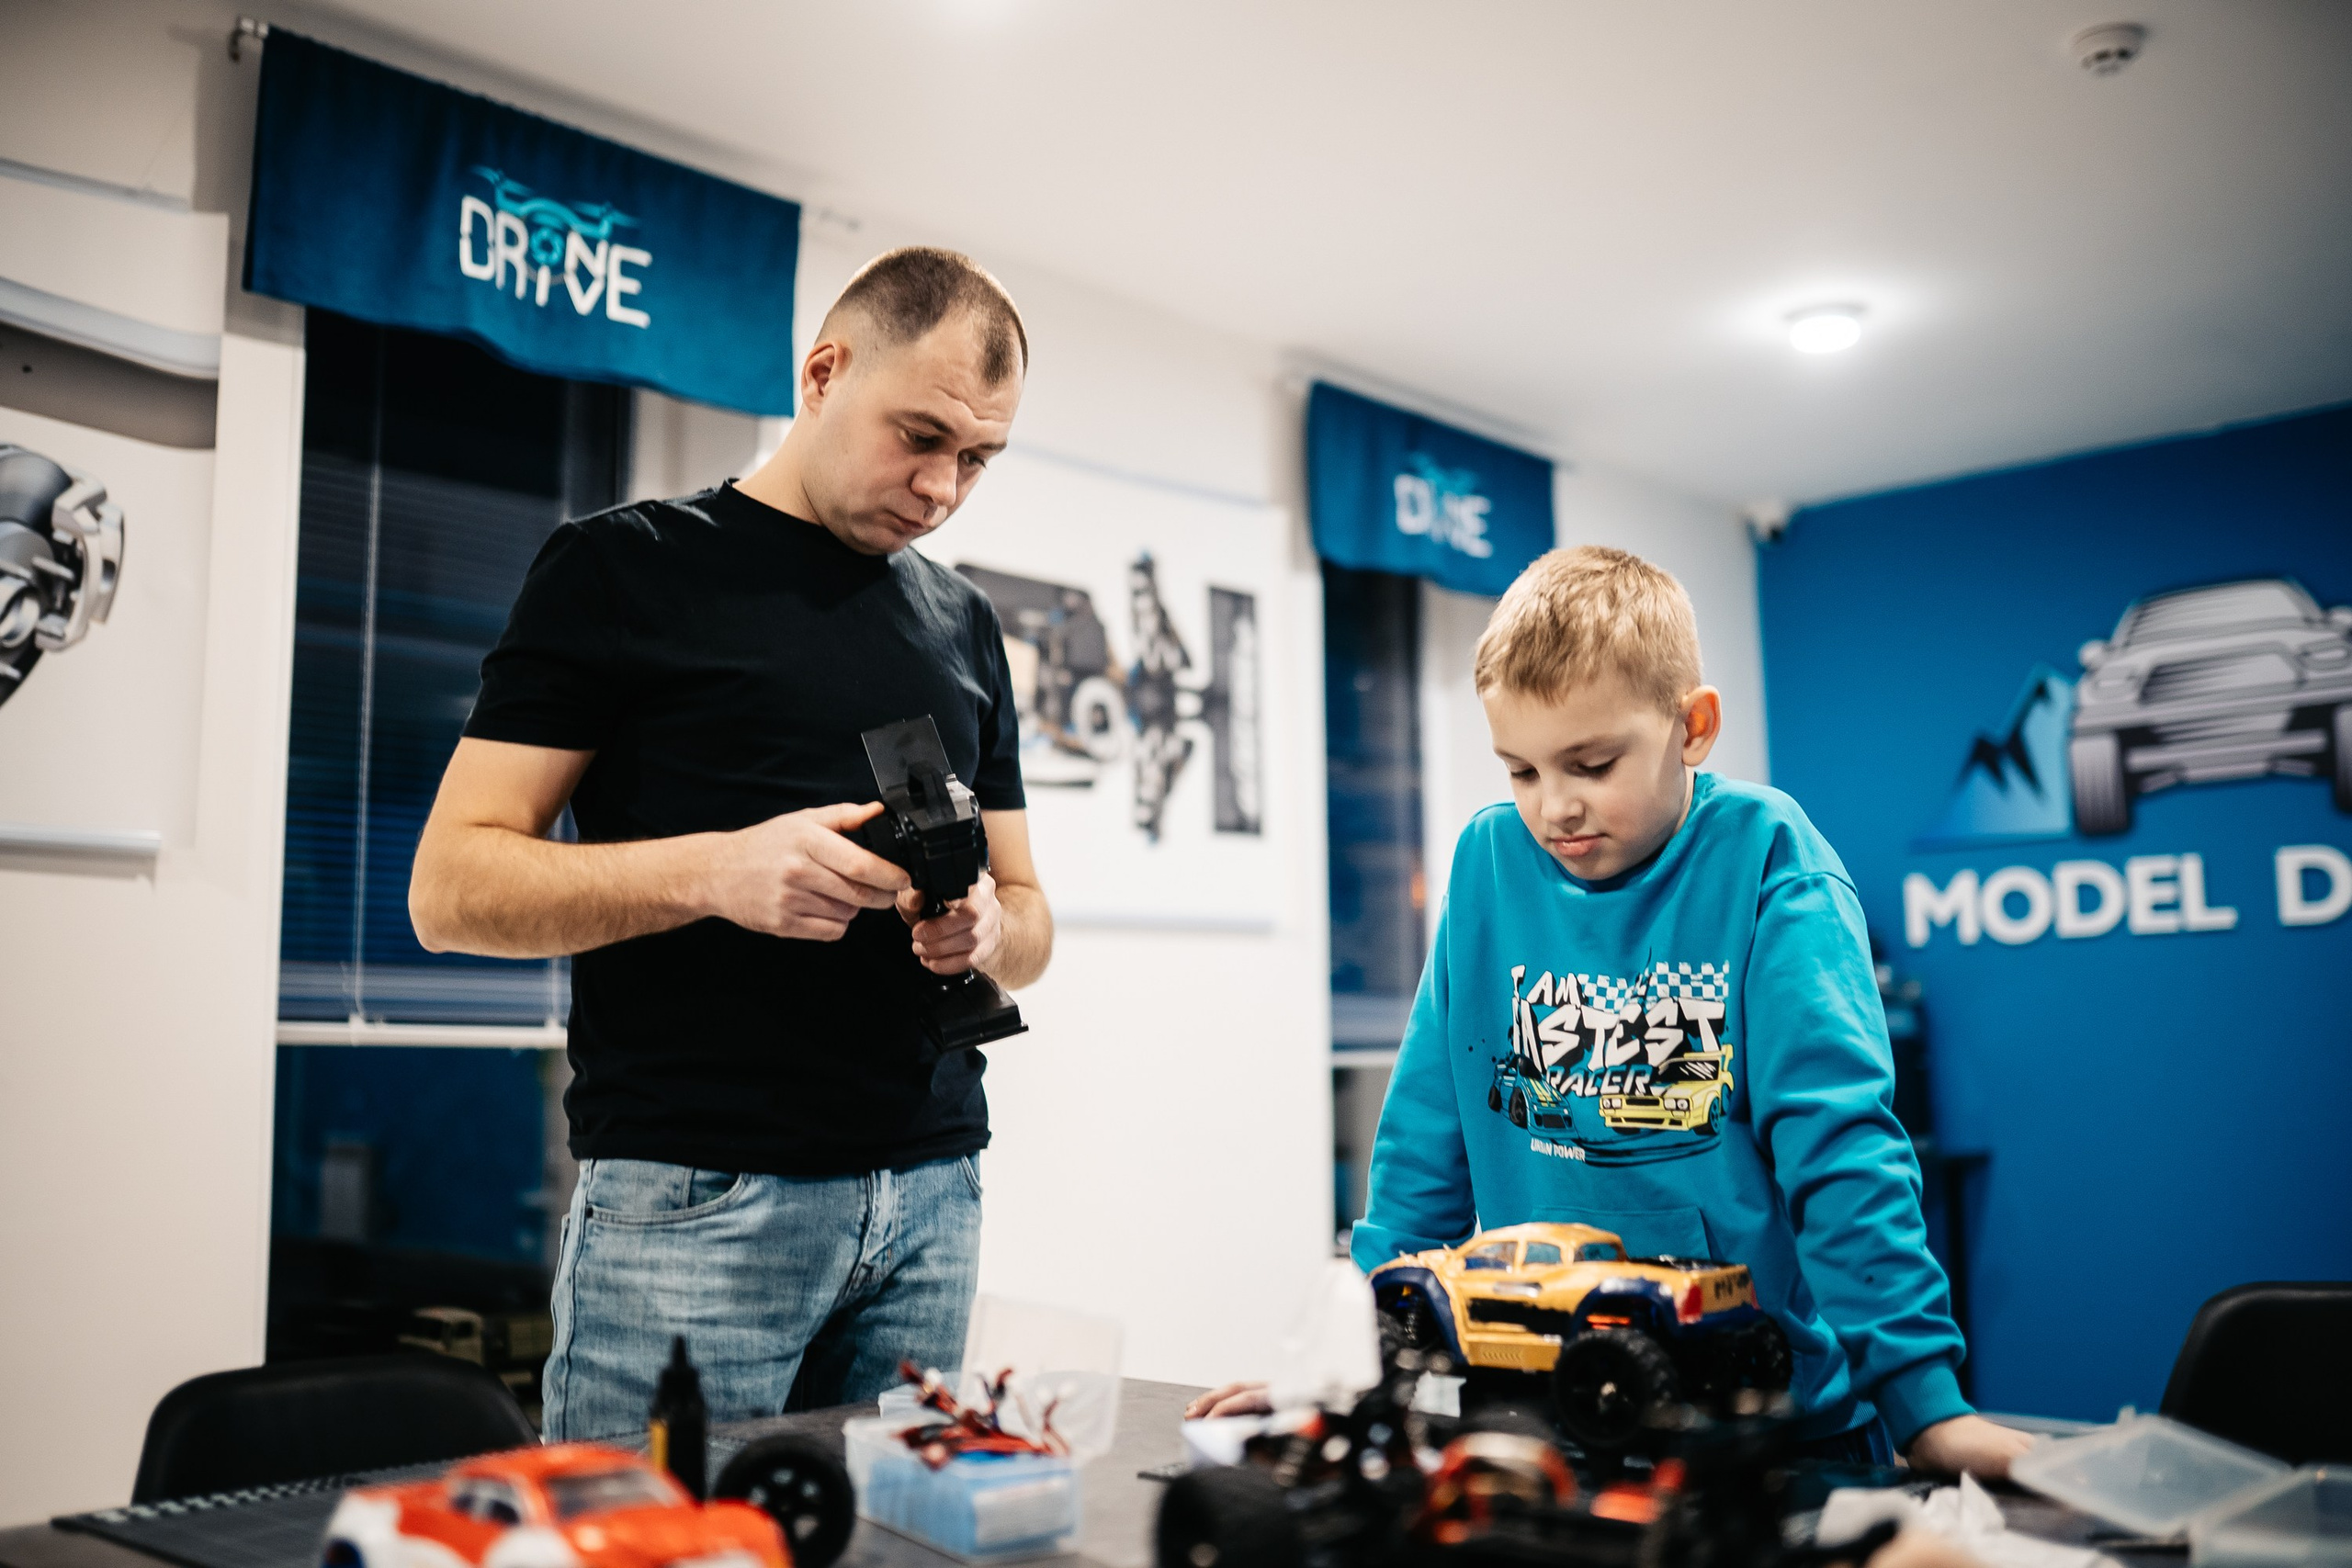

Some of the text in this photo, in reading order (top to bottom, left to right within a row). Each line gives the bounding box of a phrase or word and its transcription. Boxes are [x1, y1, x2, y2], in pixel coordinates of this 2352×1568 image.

[1903, 852, 2239, 948] MODEL
[1545, 1064, 1654, 1098] RACER
[1553, 1143, 1586, 1163] POWER
